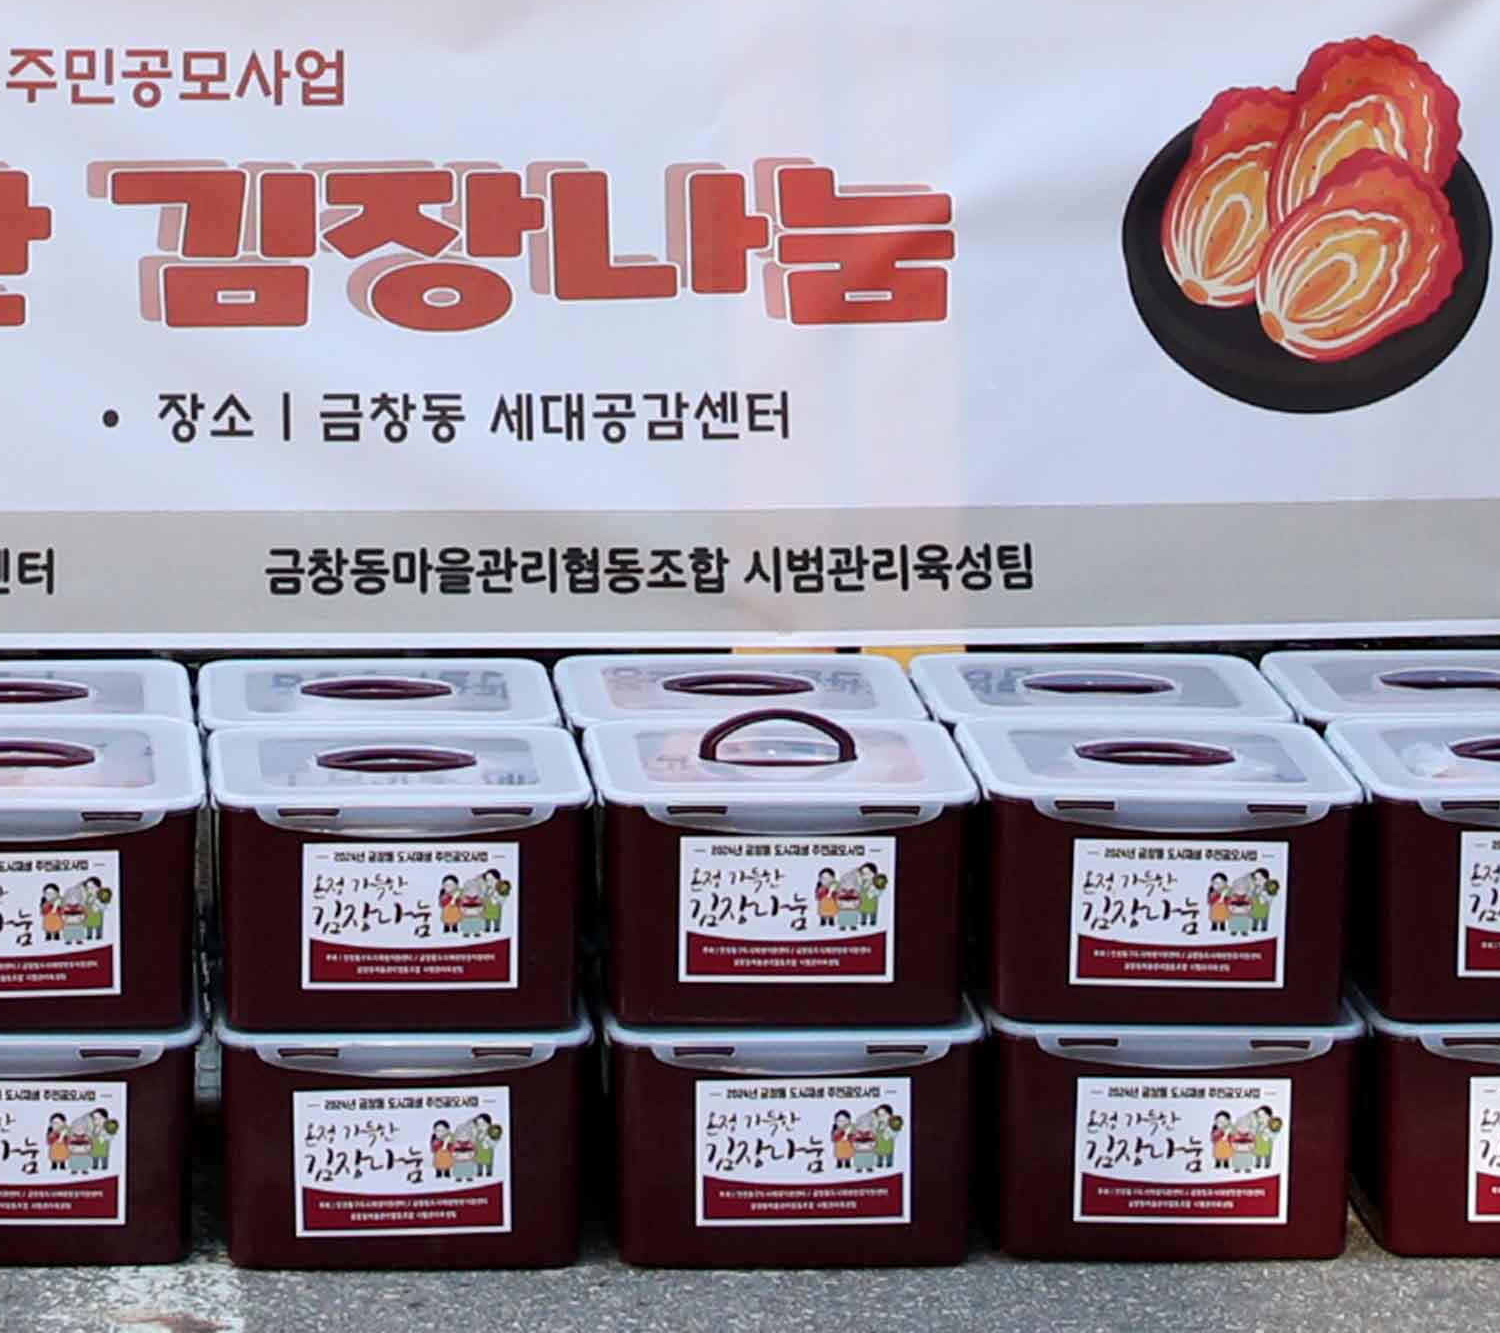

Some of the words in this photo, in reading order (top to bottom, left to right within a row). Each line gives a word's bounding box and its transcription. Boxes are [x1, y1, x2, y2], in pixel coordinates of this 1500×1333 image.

[7, 48, 345, 106] 주민공모사업
[88, 154, 957, 332] 김장나눔
[159, 393, 254, 443] 장소
[320, 393, 465, 444] 금창동
[490, 391, 789, 444] 세대공감센터
[265, 546, 730, 596] 금창동마을관리협동조합
[743, 542, 1033, 594] 시범관리육성팀
